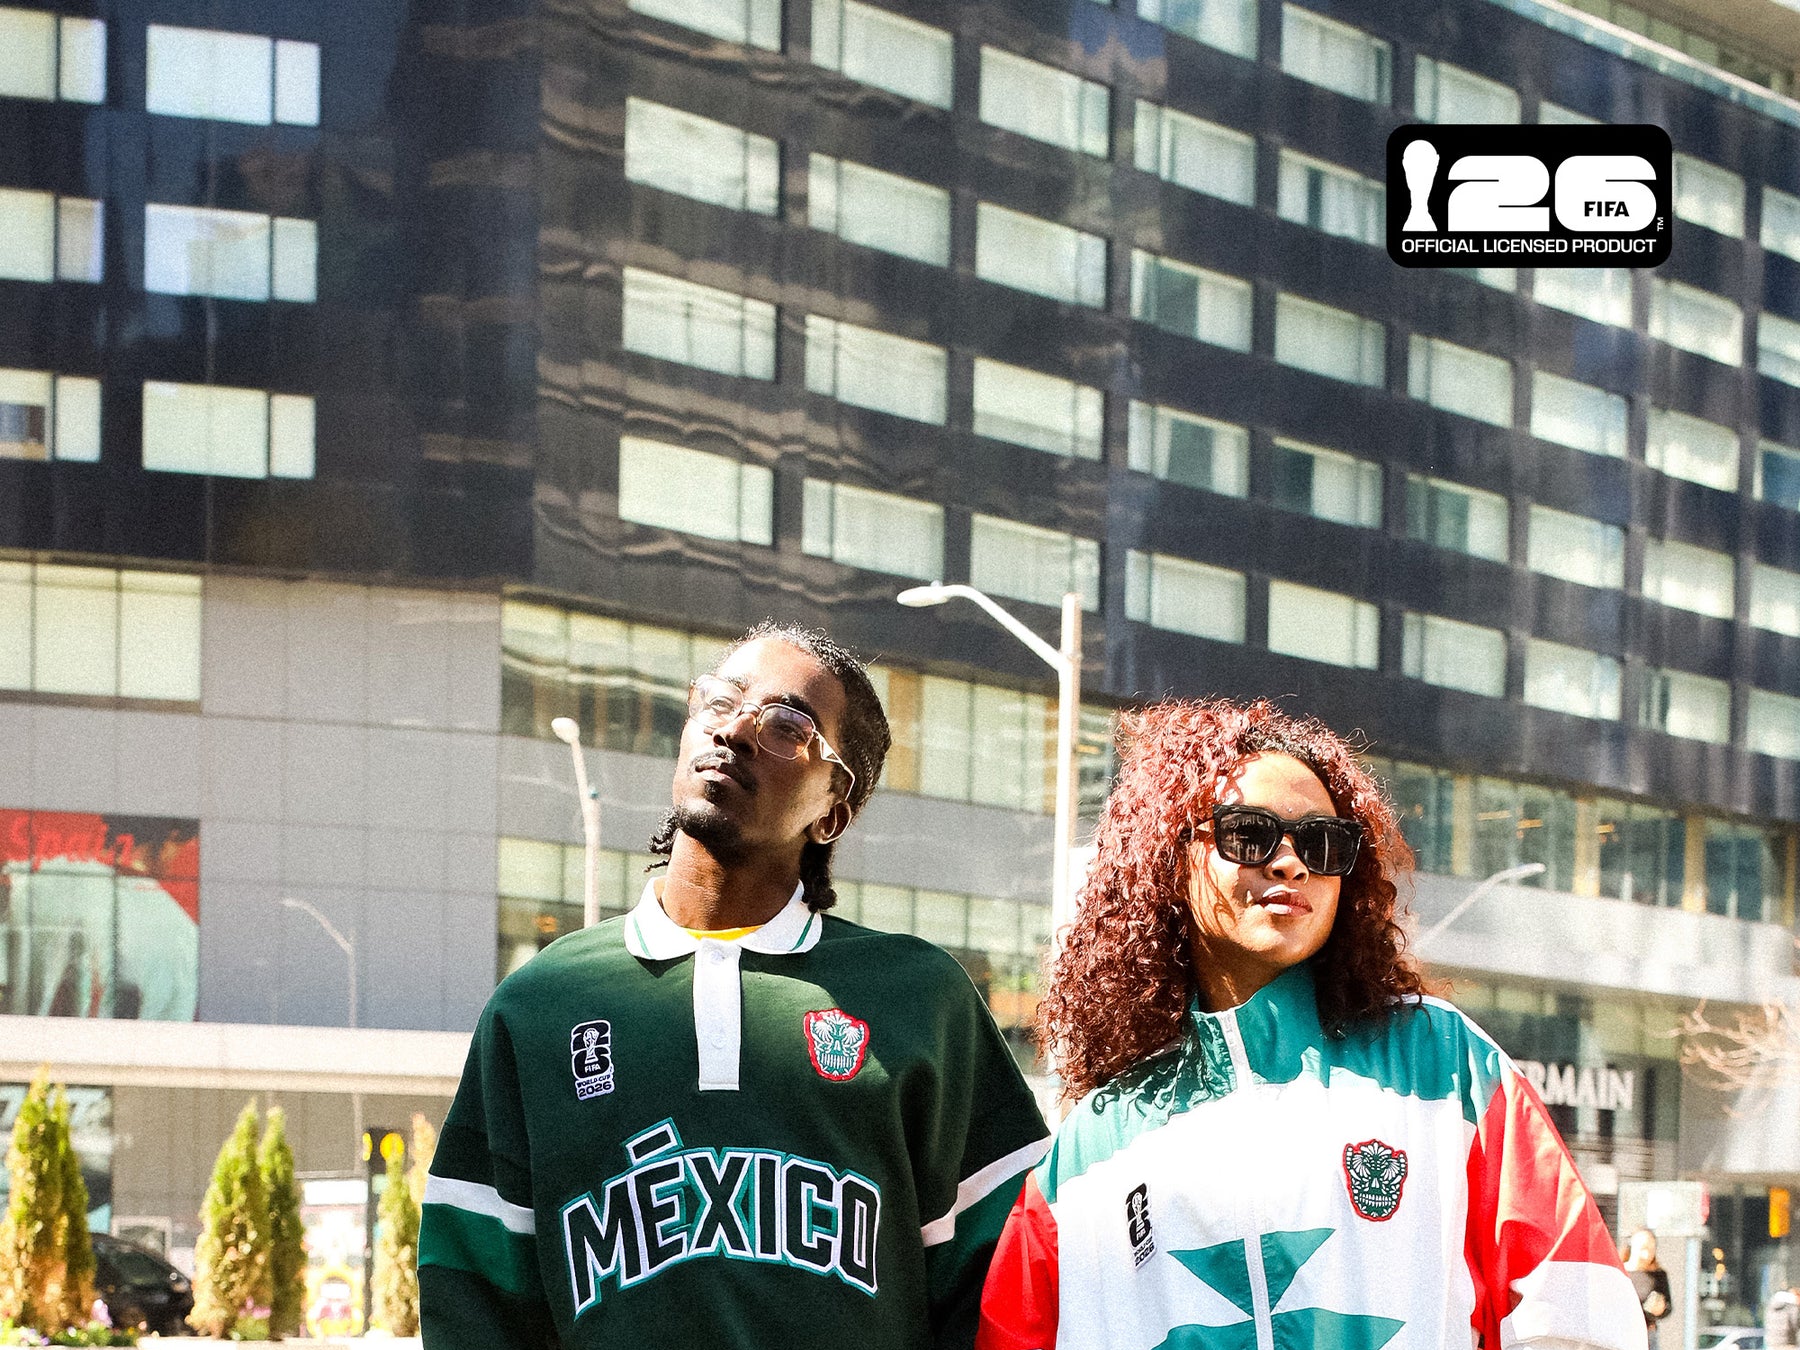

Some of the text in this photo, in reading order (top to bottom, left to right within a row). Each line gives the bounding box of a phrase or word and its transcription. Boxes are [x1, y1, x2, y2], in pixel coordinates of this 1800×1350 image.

[584, 1063, 602, 1073] FIFA
[576, 1074, 611, 1089] WORLD CUP
[578, 1081, 612, 1098] 2026
[557, 1116, 882, 1322] MÉXICO
